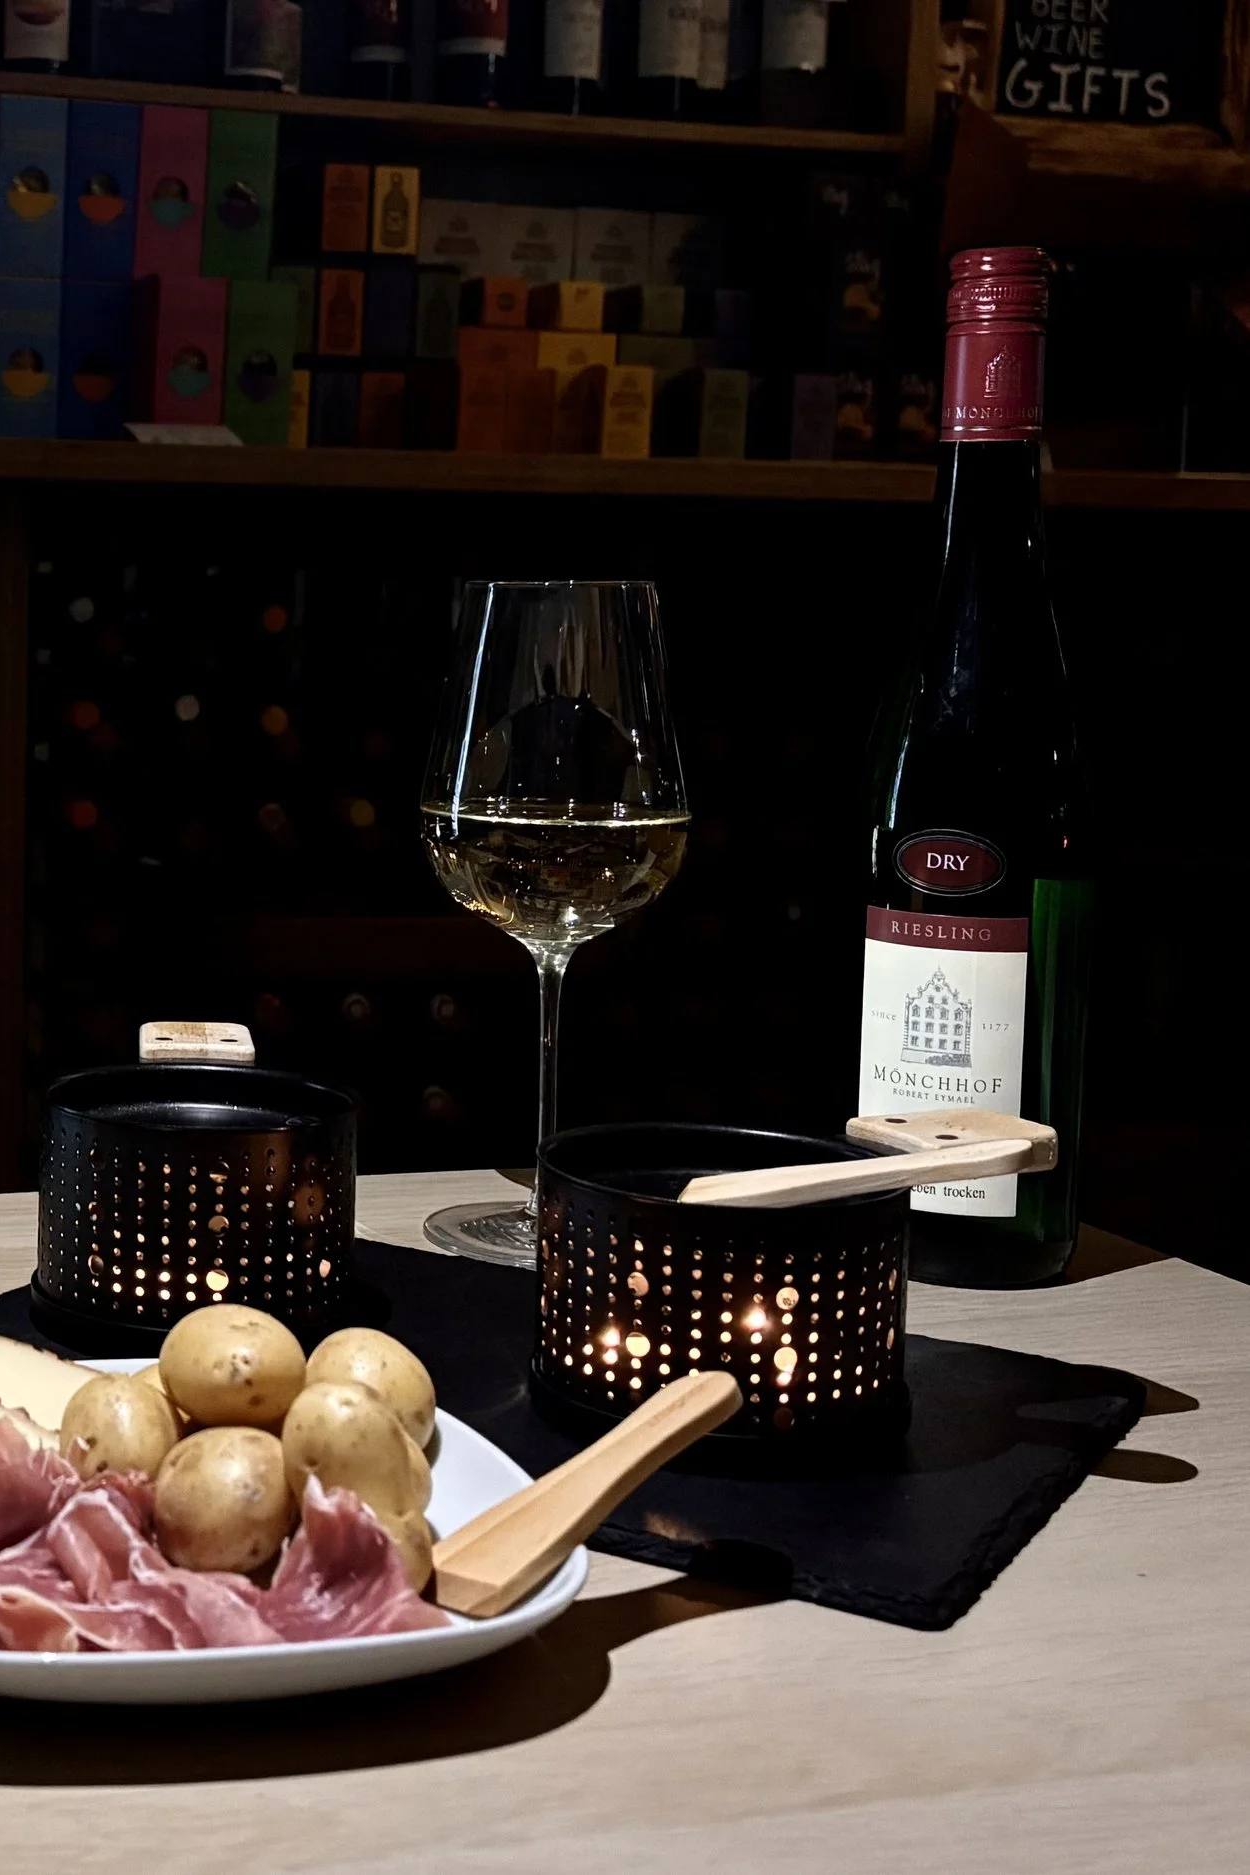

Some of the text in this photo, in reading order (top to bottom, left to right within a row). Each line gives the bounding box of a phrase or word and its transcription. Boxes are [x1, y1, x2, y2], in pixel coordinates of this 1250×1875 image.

[1031, 0, 1109, 24] BEER
[1014, 20, 1105, 60] WINE
[1005, 57, 1172, 119] GIFTS
[926, 852, 970, 872] DRY
[891, 920, 992, 941] RIESLING
[870, 1009, 1010, 1032] since 1177
[873, 1064, 1003, 1094] MÖNCHHOF
[892, 1088, 976, 1104] ROBERT EYMAEL
[943, 1186, 986, 1199] trocken
